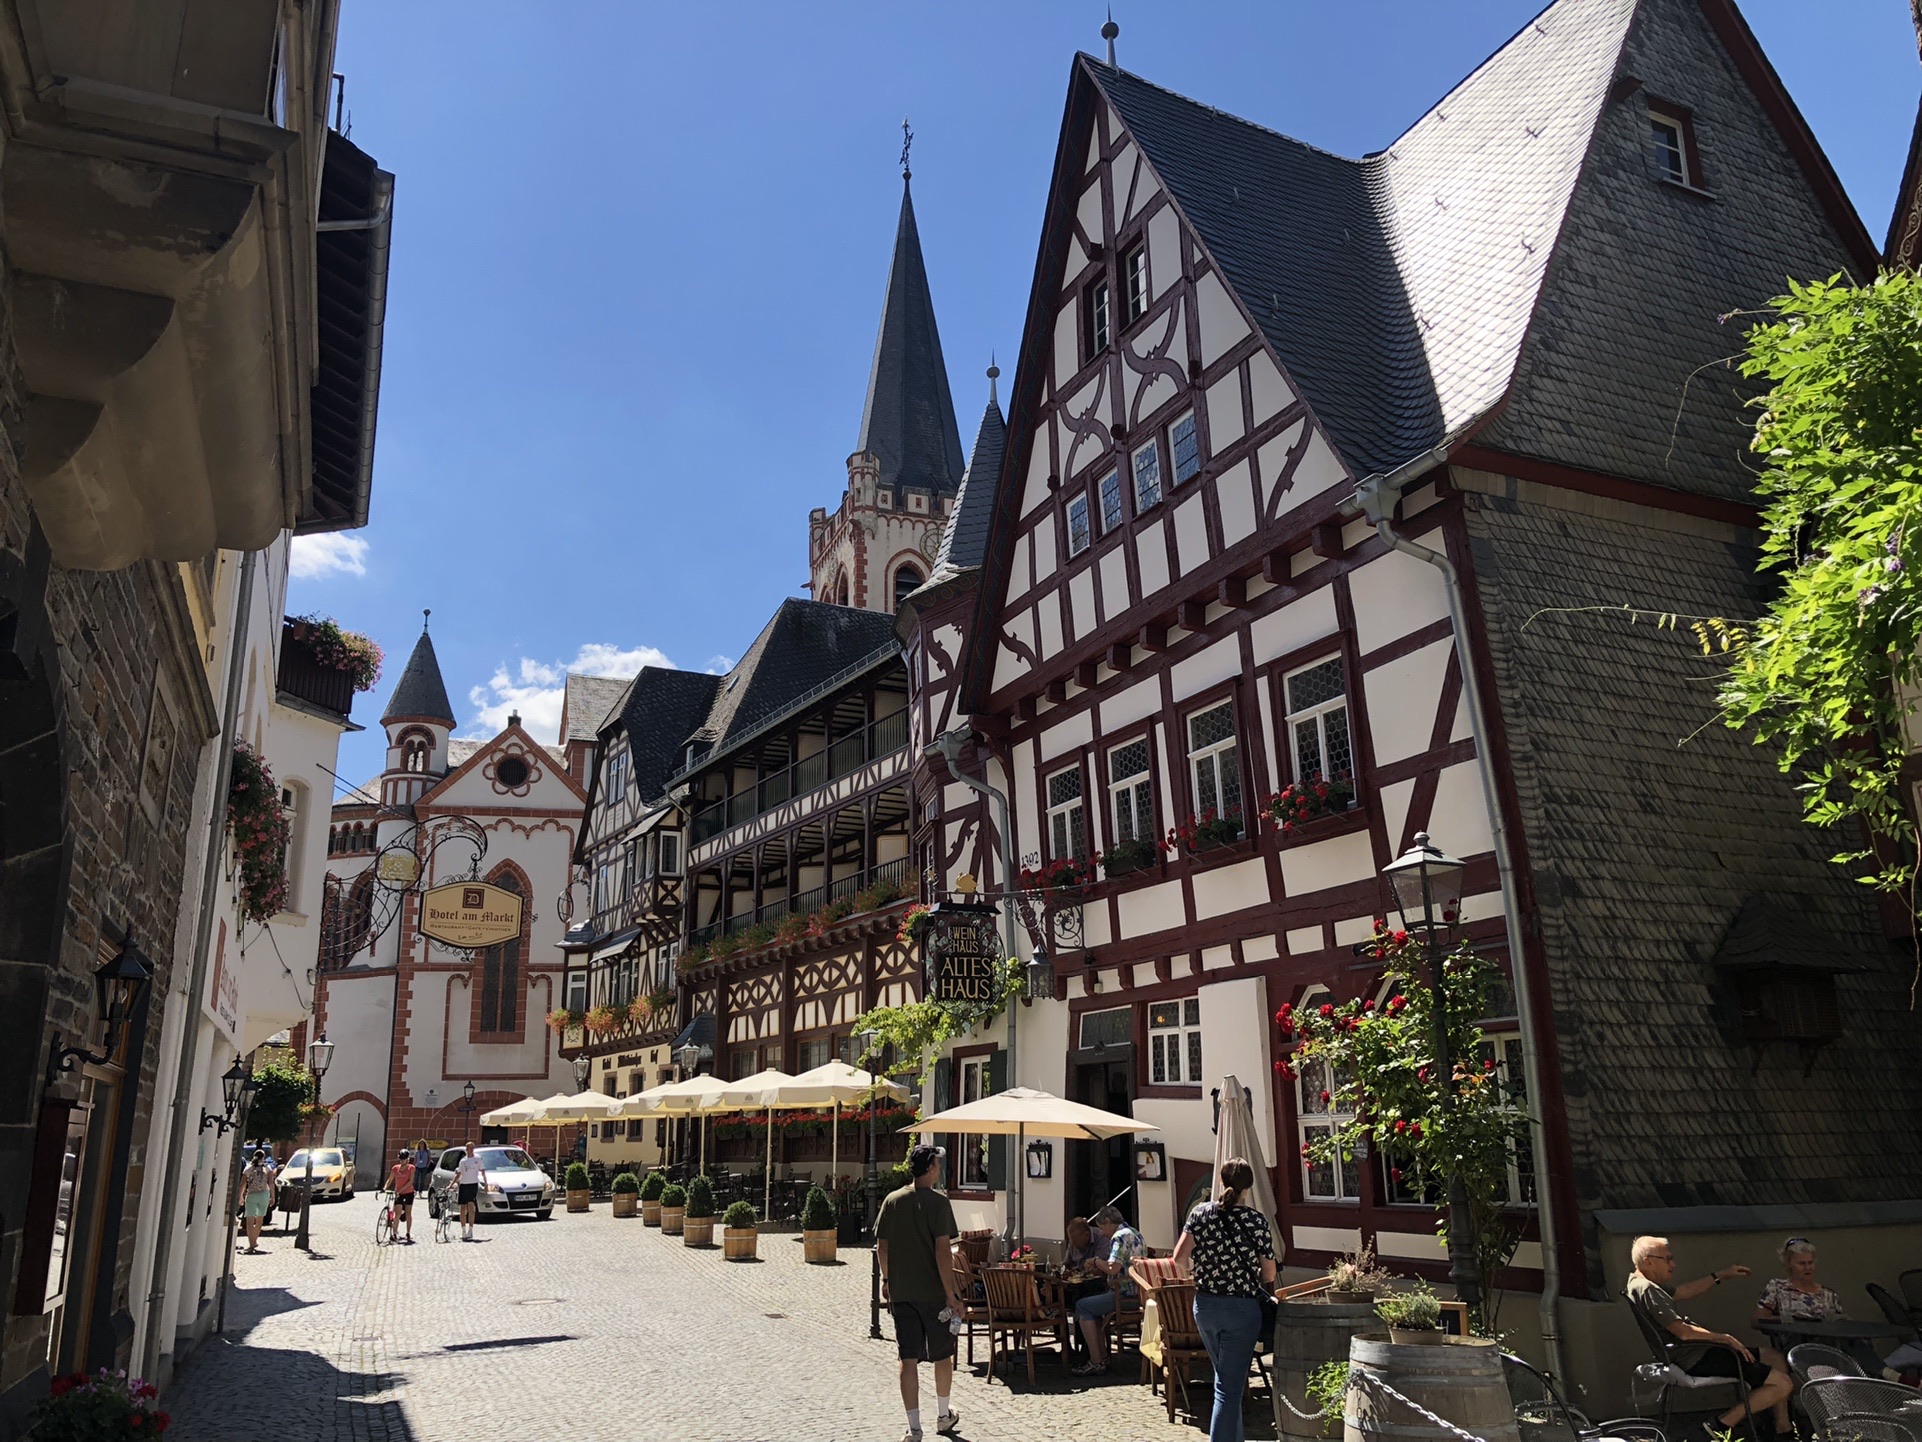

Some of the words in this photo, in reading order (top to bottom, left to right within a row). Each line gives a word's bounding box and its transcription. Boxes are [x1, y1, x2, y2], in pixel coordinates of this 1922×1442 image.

[429, 908, 459, 920] Hotel
[462, 913, 478, 921] am
[480, 911, 514, 923] Markt
[953, 926, 976, 940] WEIN
[952, 940, 979, 954] HAUS
[940, 957, 991, 977] ALTES
[941, 978, 991, 1000] HAUS
